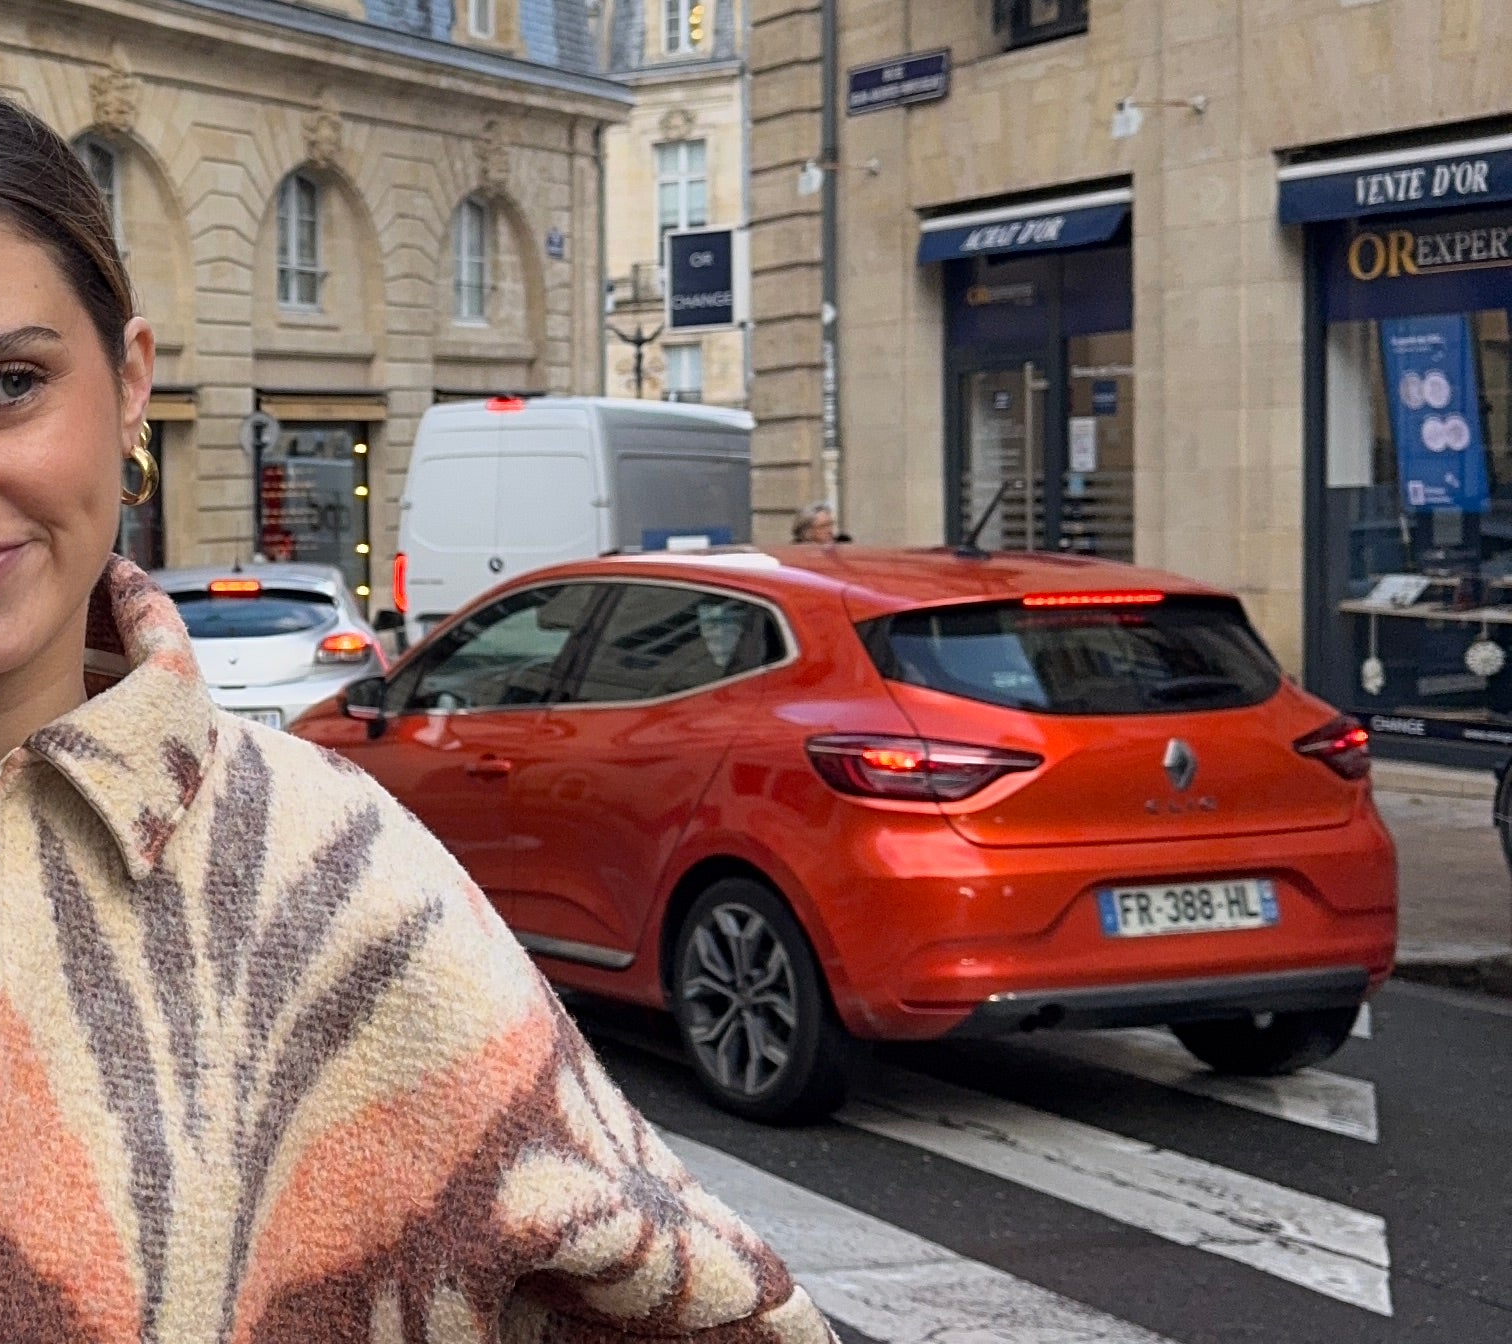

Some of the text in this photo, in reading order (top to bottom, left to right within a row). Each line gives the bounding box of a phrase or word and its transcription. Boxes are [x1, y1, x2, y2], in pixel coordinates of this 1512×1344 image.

[1355, 159, 1489, 206] VENTE D'OR
[671, 290, 733, 311] CHANGE
[1370, 713, 1426, 736] CHANGE
[1118, 885, 1260, 926] FR-388-HL
